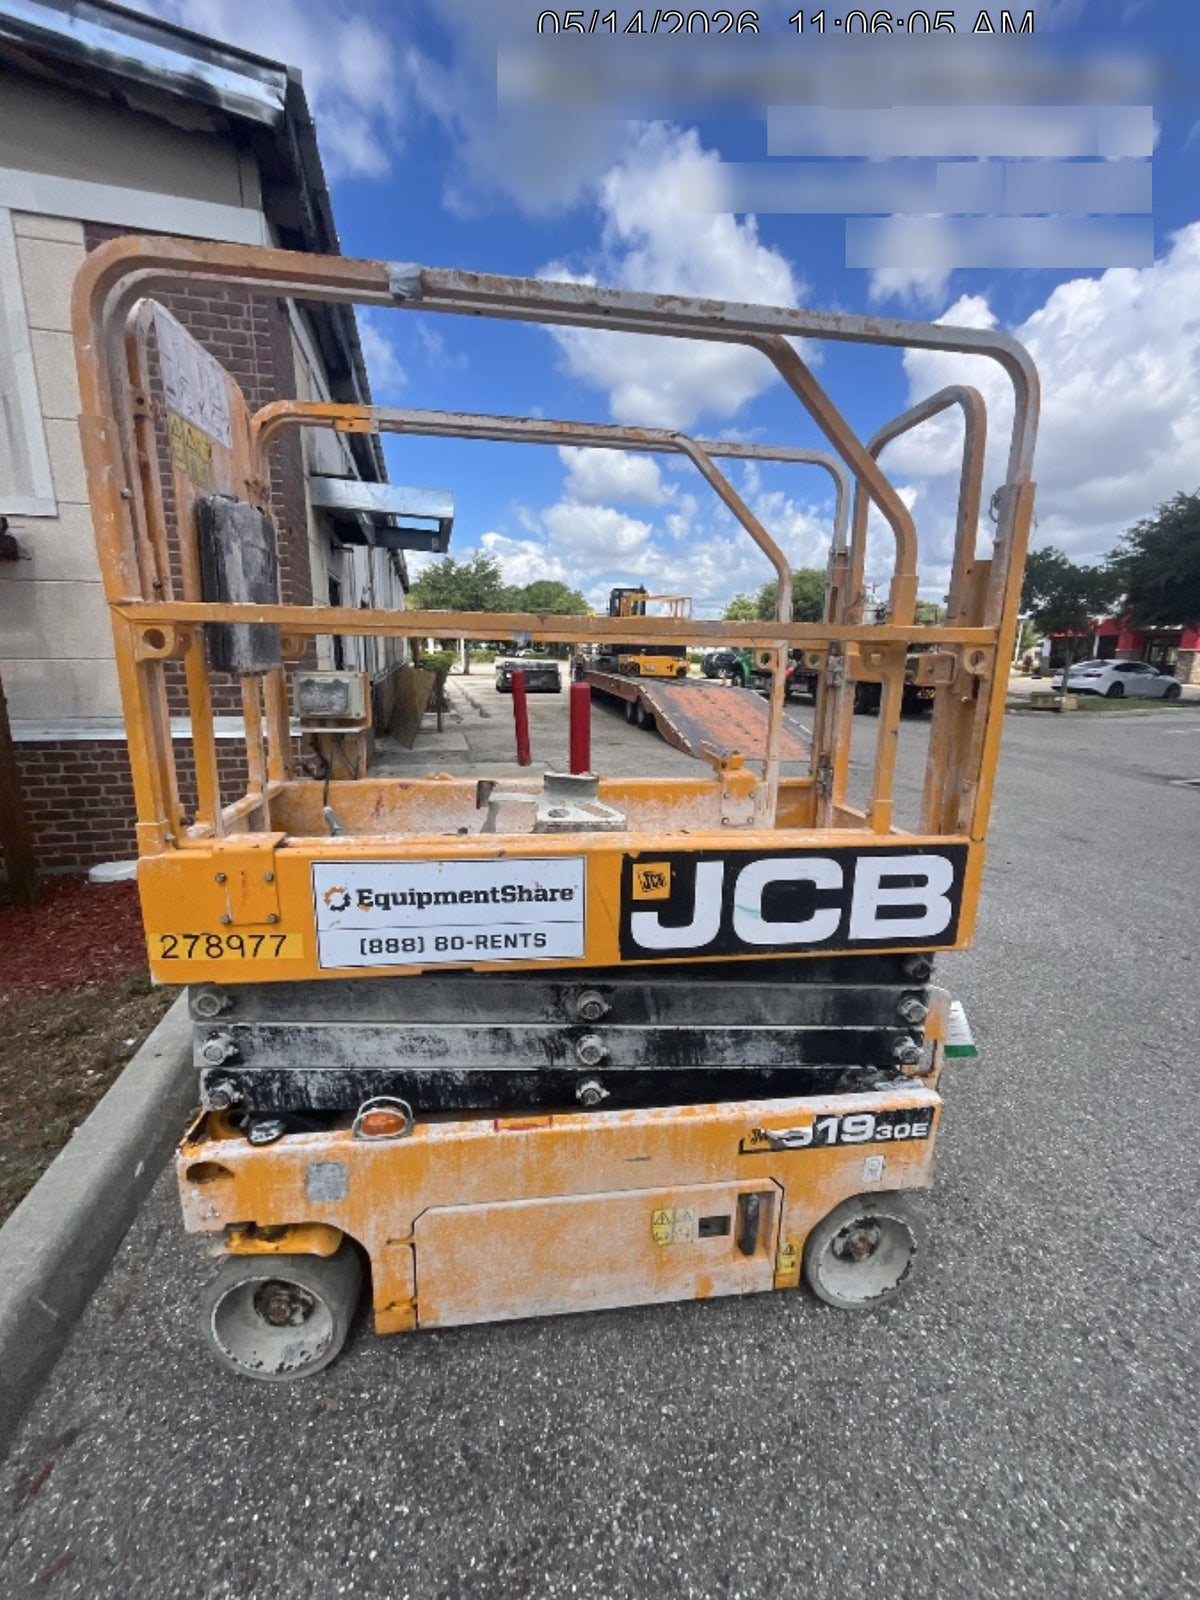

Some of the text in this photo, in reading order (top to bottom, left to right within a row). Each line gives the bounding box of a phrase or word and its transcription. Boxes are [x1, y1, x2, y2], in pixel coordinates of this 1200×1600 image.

[356, 884, 575, 912] EquipmentShare
[630, 854, 954, 950] JCB
[160, 933, 287, 959] 278977
[434, 932, 547, 951] 80-RENTS
